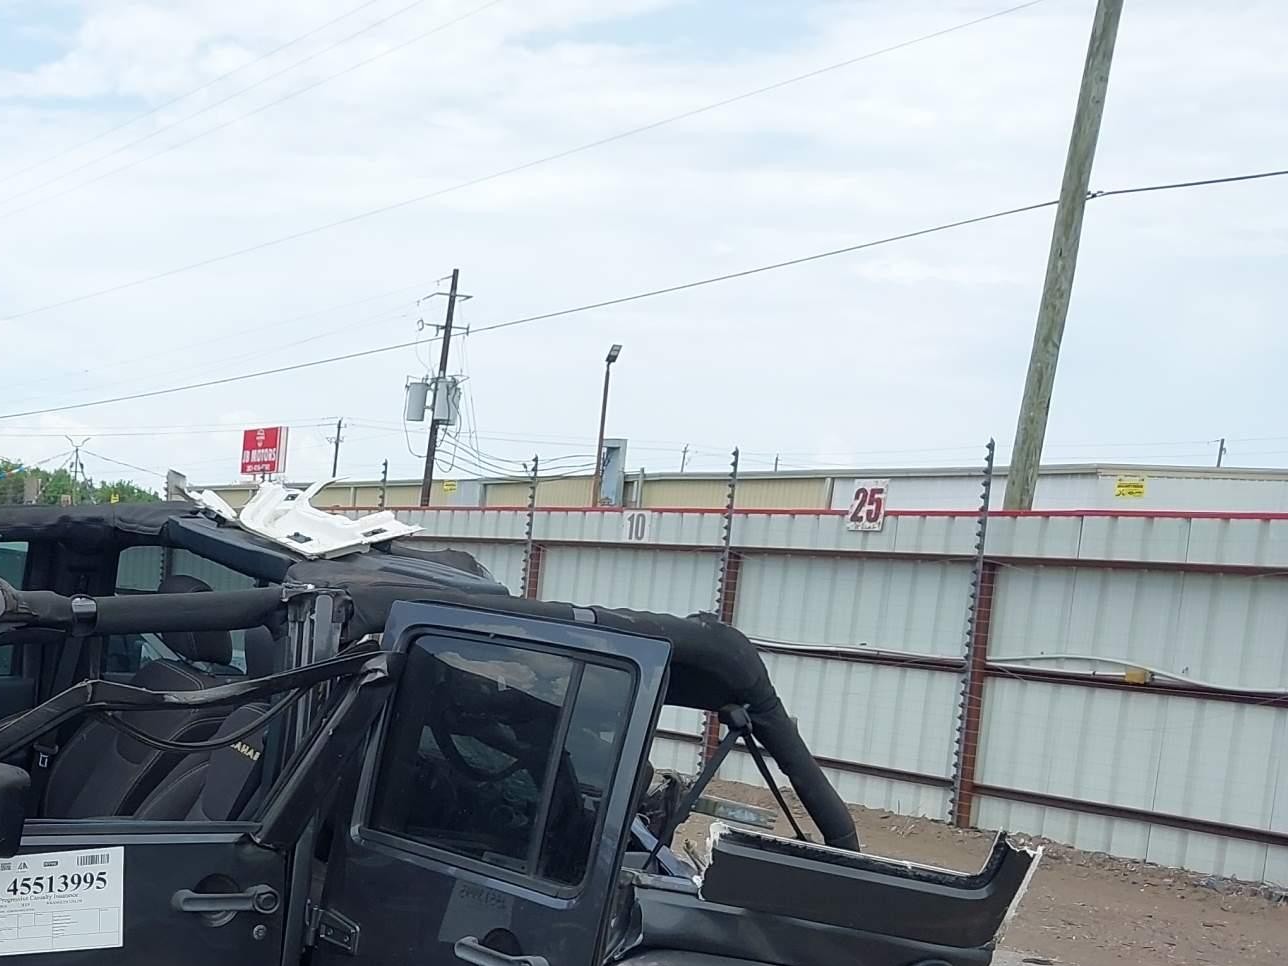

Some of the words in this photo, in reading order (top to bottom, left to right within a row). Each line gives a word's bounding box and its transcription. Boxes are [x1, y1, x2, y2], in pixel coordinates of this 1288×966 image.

[251, 447, 276, 462] MOTORS
[850, 487, 884, 523] 25
[627, 512, 646, 540] 10
[7, 871, 107, 895] 45513995
[0, 896, 29, 904] Progressive
[29, 894, 52, 902] Casualty
